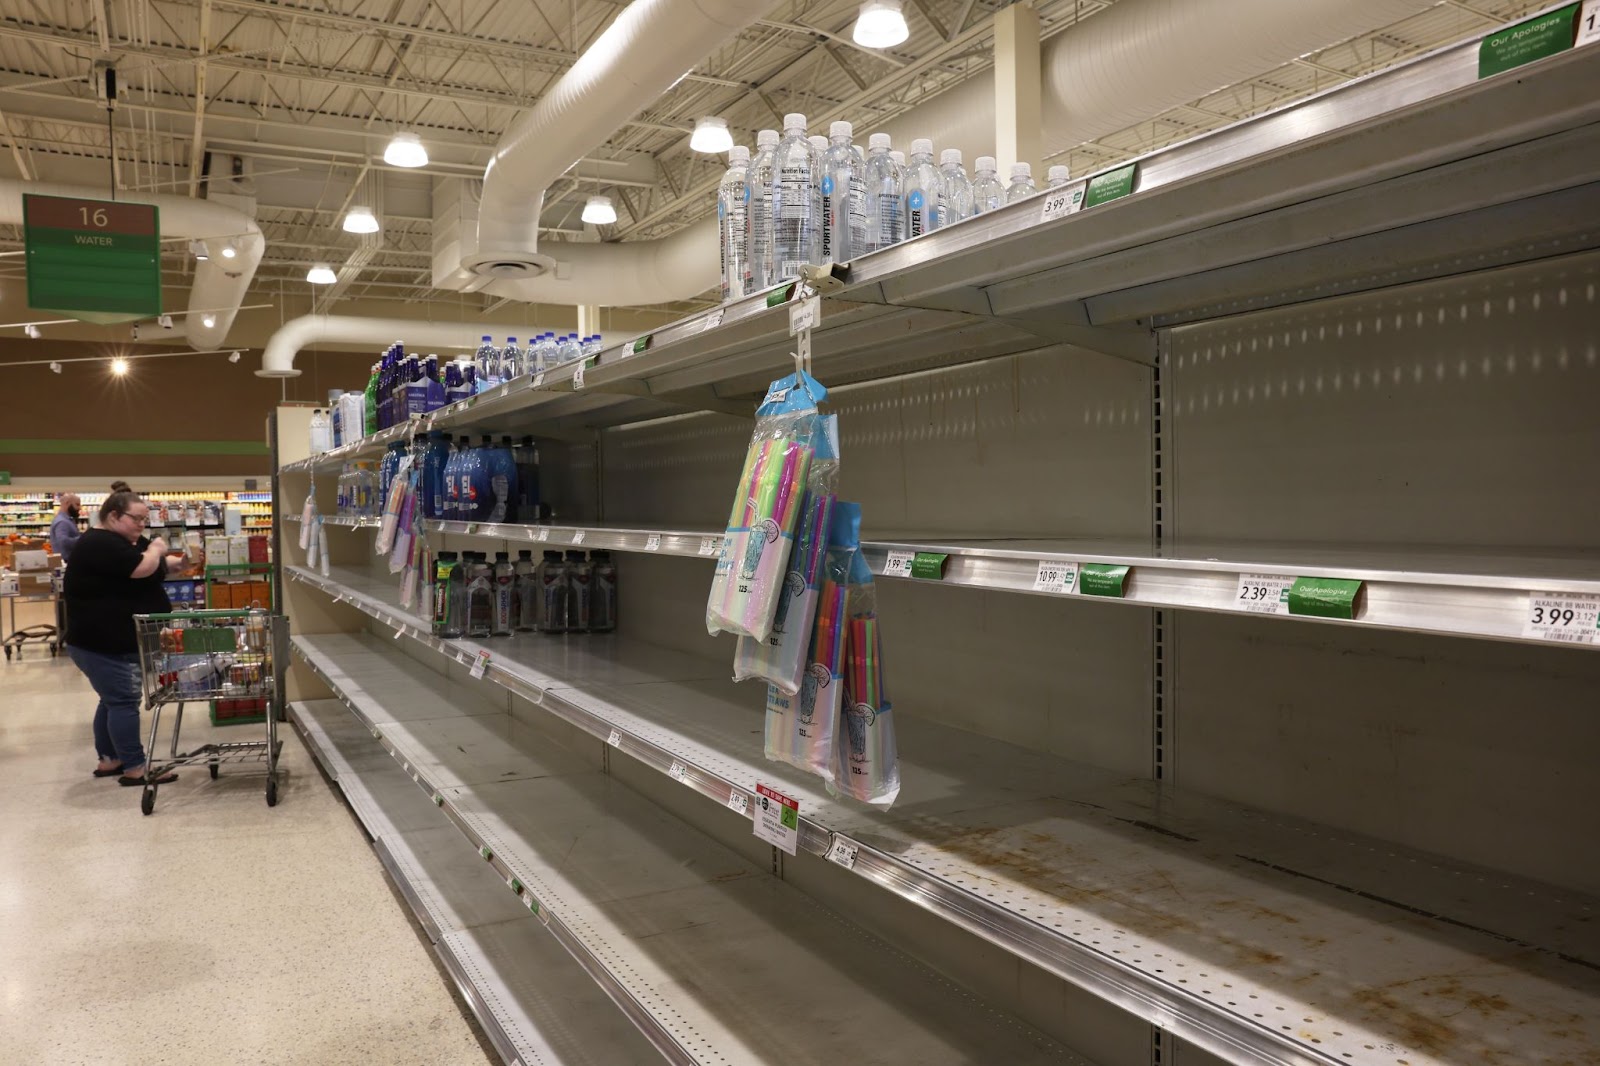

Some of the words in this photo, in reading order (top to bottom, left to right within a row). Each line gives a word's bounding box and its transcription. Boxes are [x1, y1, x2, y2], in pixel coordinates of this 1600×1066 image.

[1491, 35, 1509, 48] Our
[1511, 17, 1561, 40] Apologies
[79, 207, 108, 227] 16
[823, 196, 831, 256] SPORTWATER
[74, 235, 113, 246] WATER
[888, 559, 901, 568] 1.99
[1039, 571, 1057, 582] 10.99
[739, 585, 748, 593] 125
[1240, 586, 1267, 601] 2.39
[1312, 586, 1348, 595] Apologies
[1575, 602, 1597, 610] WATER
[1531, 607, 1574, 626] 3.99
[852, 766, 861, 775] 125
